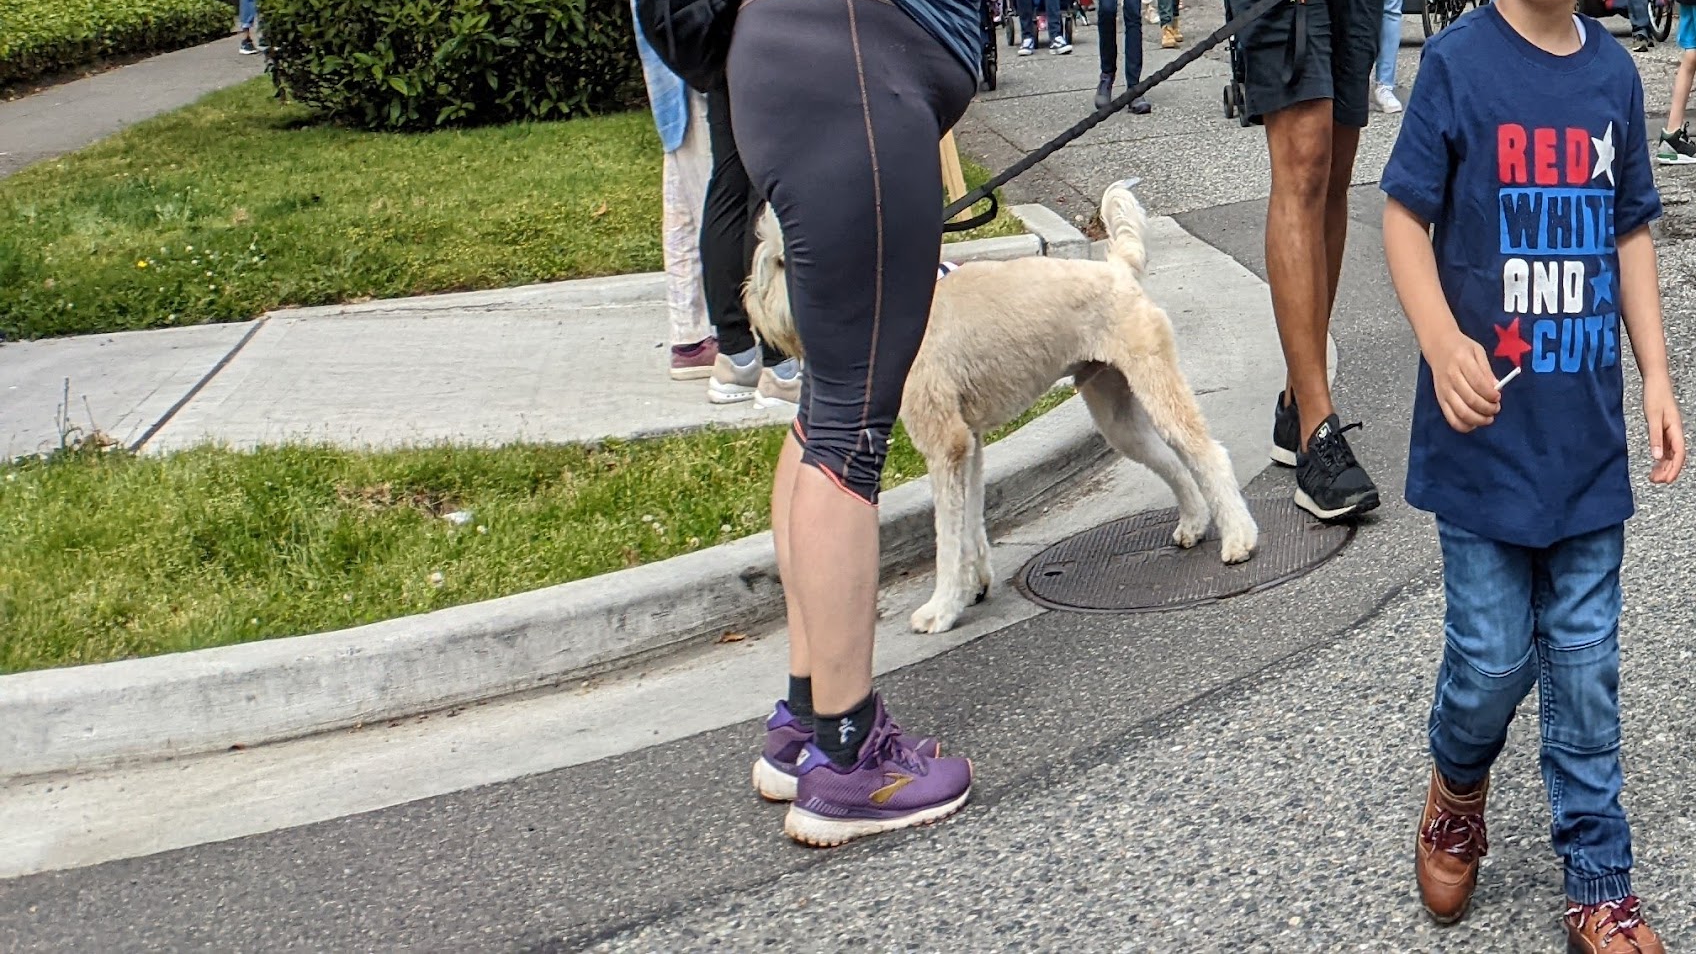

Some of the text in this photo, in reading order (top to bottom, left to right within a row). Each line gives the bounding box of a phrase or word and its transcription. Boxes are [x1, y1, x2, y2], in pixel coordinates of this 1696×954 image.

[1497, 123, 1589, 185] RED
[1501, 191, 1615, 249] WHITE
[1503, 258, 1585, 314] AND
[1532, 312, 1616, 373] CUTE
